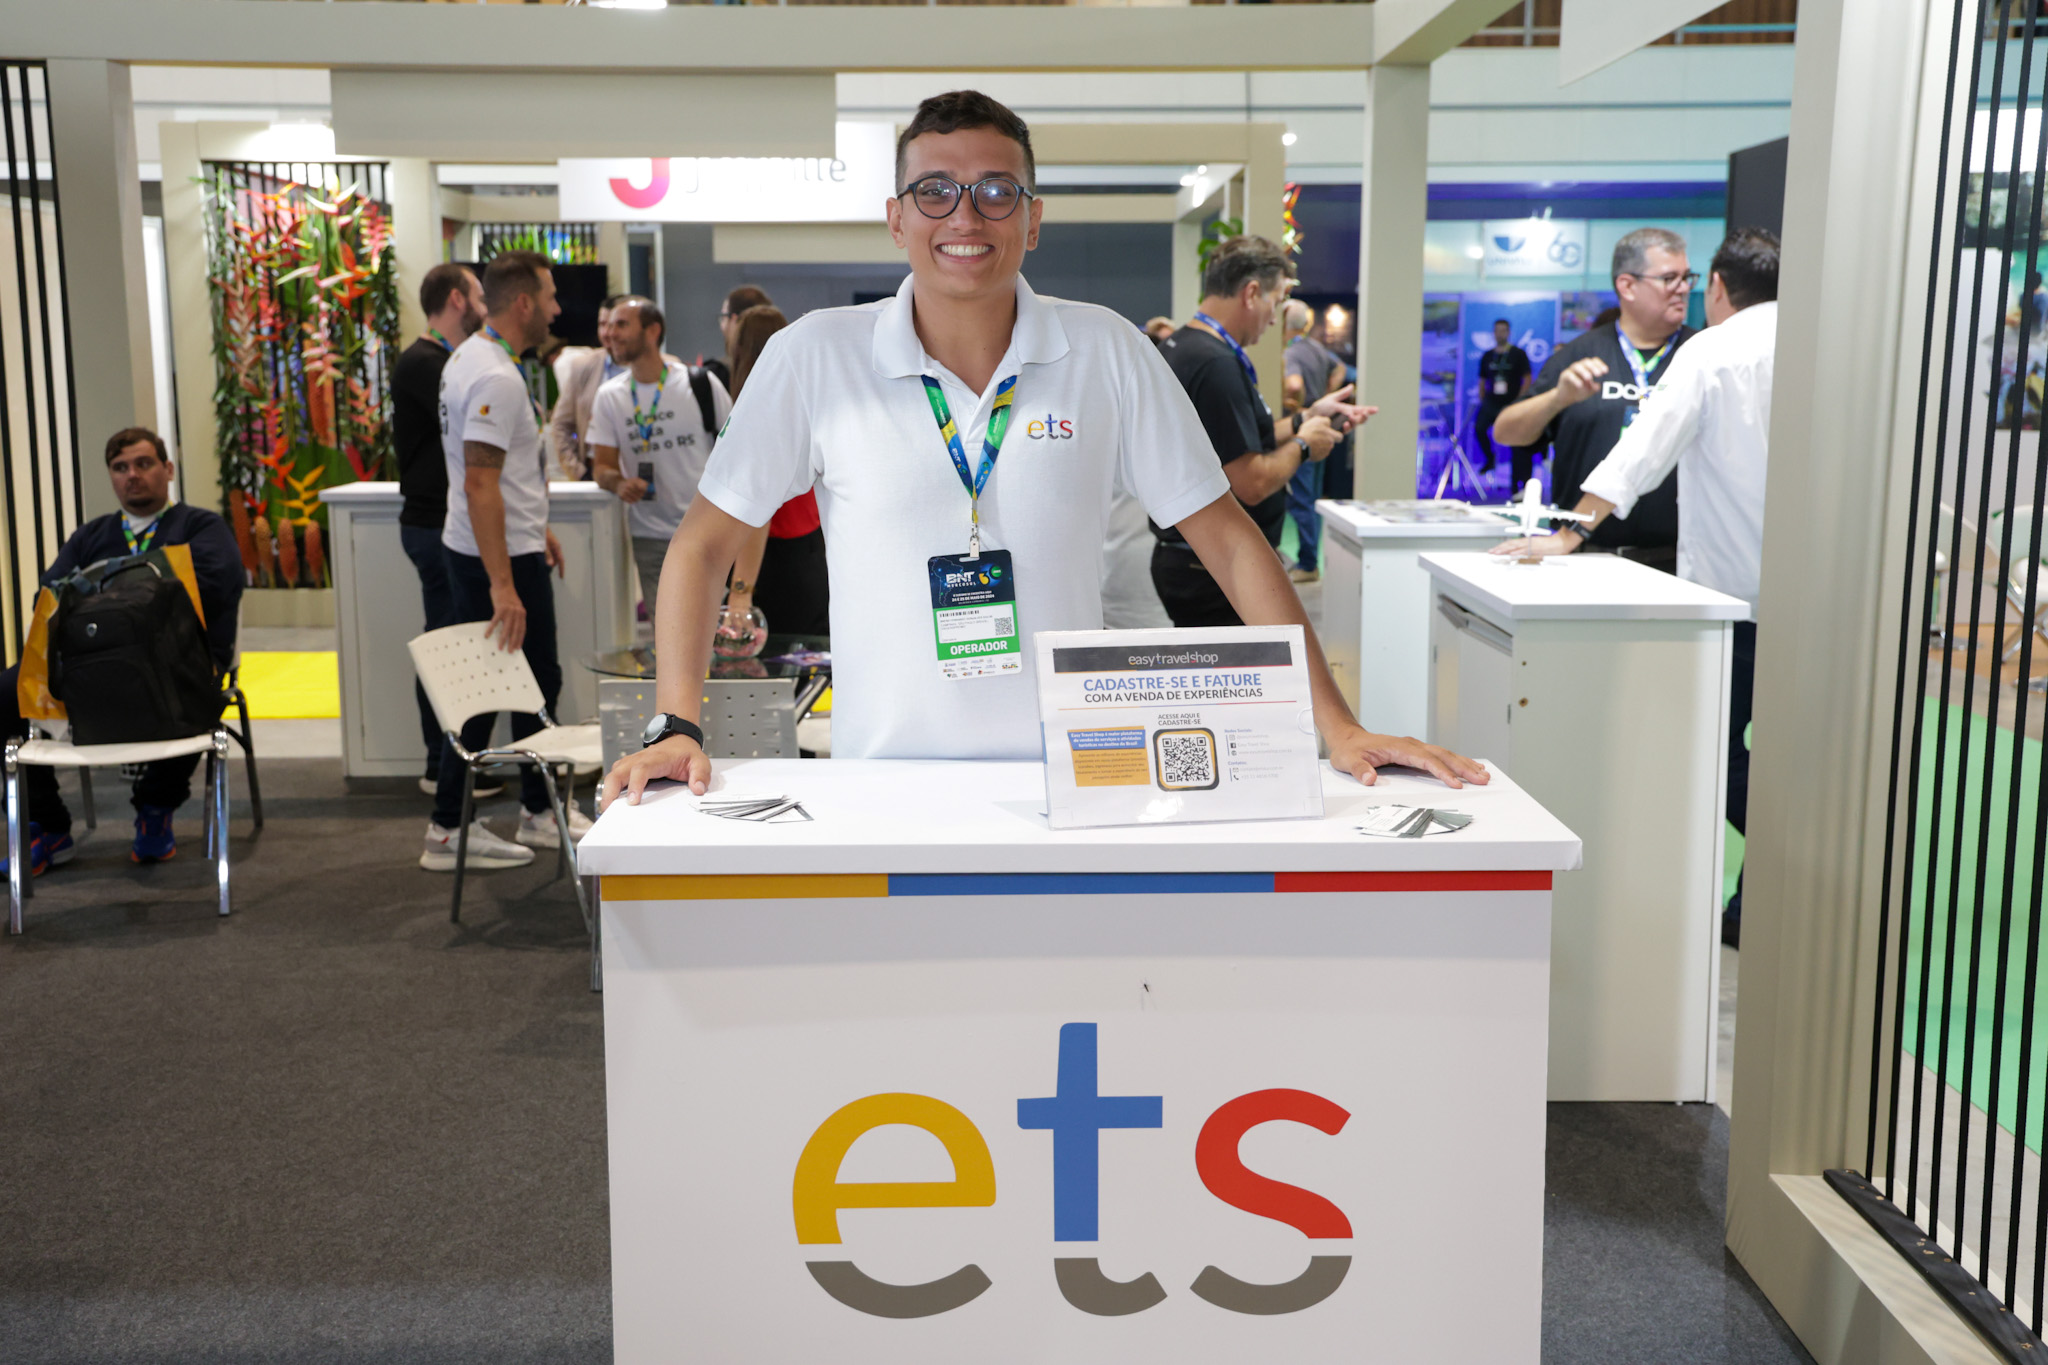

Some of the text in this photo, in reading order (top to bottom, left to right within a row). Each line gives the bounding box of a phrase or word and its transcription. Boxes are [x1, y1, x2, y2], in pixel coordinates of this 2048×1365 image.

[1027, 413, 1074, 440] ets
[950, 640, 1008, 656] OPERADOR
[1083, 673, 1262, 692] CADASTRE-SE E FATURE
[1085, 687, 1263, 703] COM A VENDA DE EXPERIÊNCIAS
[1158, 718, 1201, 726] CADASTRE-SE
[792, 1022, 1355, 1319] ets
